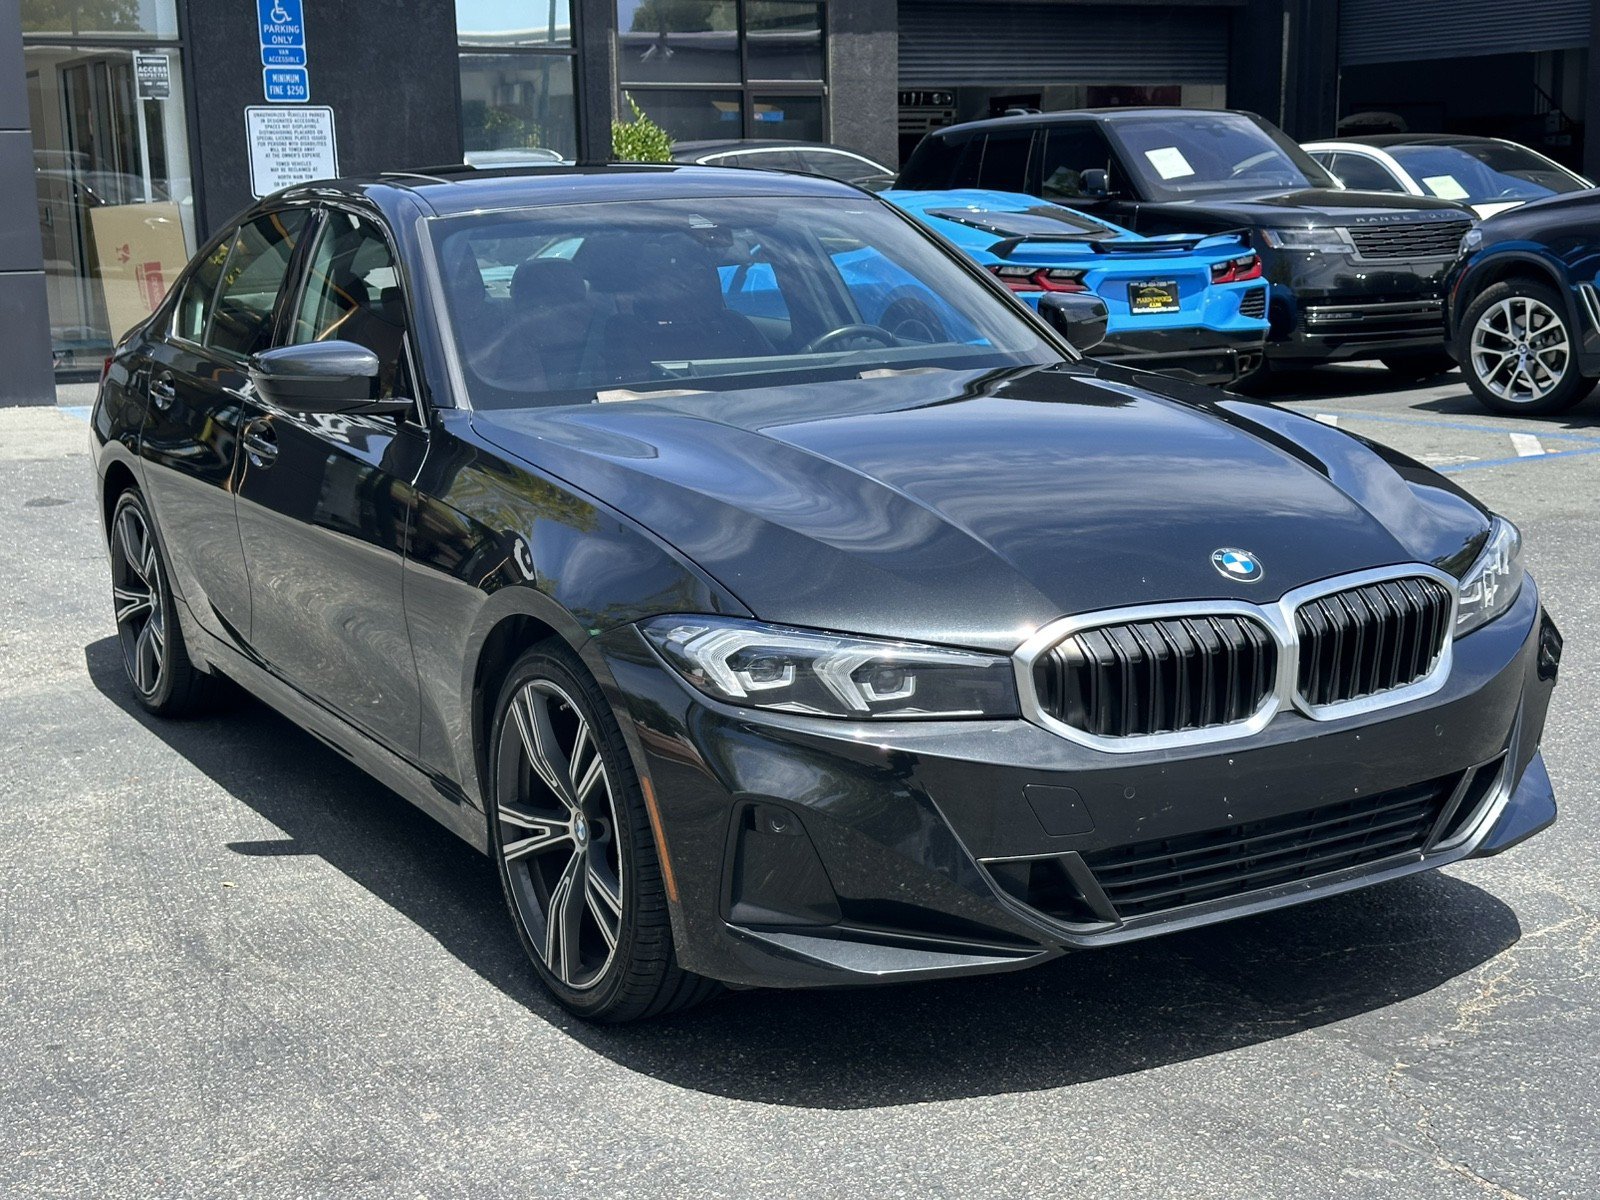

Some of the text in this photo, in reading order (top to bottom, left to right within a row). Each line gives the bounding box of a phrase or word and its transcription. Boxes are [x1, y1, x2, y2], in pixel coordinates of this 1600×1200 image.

[263, 24, 300, 34] PARKING
[271, 35, 293, 44] ONLY
[272, 73, 300, 83] MINIMUM
[269, 85, 305, 96] FINE $250
